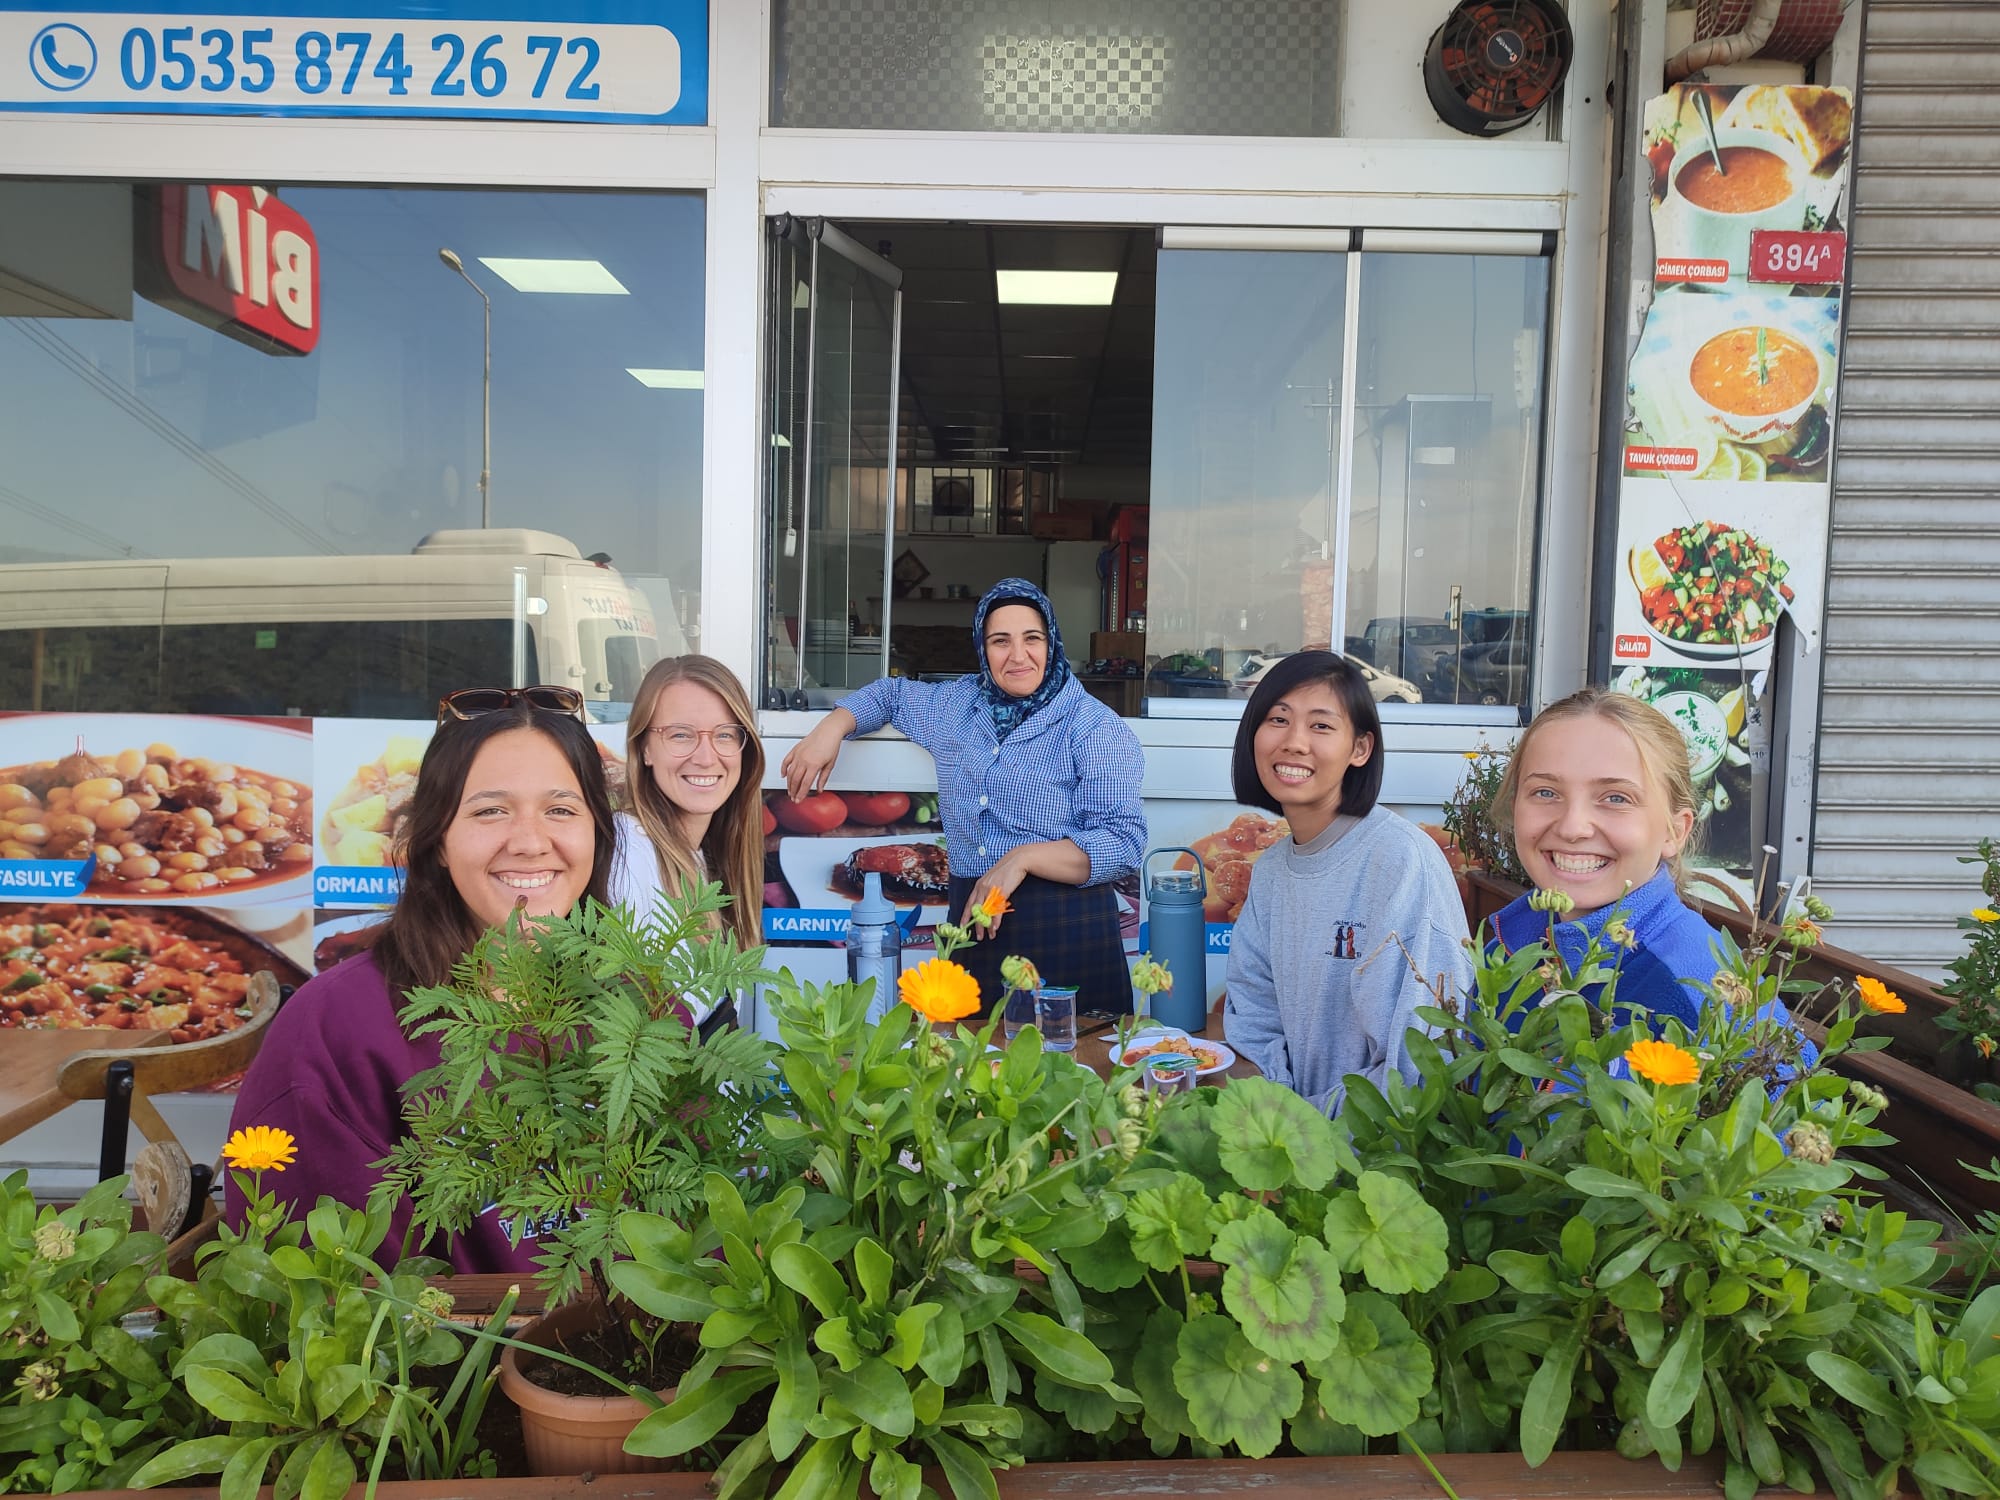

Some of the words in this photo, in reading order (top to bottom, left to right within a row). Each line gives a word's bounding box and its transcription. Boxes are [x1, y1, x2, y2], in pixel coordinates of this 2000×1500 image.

[120, 26, 275, 91] 0535
[295, 31, 412, 95] 874
[431, 33, 507, 97] 26
[526, 36, 600, 100] 72
[1687, 264, 1726, 279] ÇORBASI
[1629, 452, 1656, 465] TAVUK
[1656, 453, 1695, 467] ÇORBASI
[1618, 641, 1647, 653] SALATA
[316, 876, 384, 894] ORMAN
